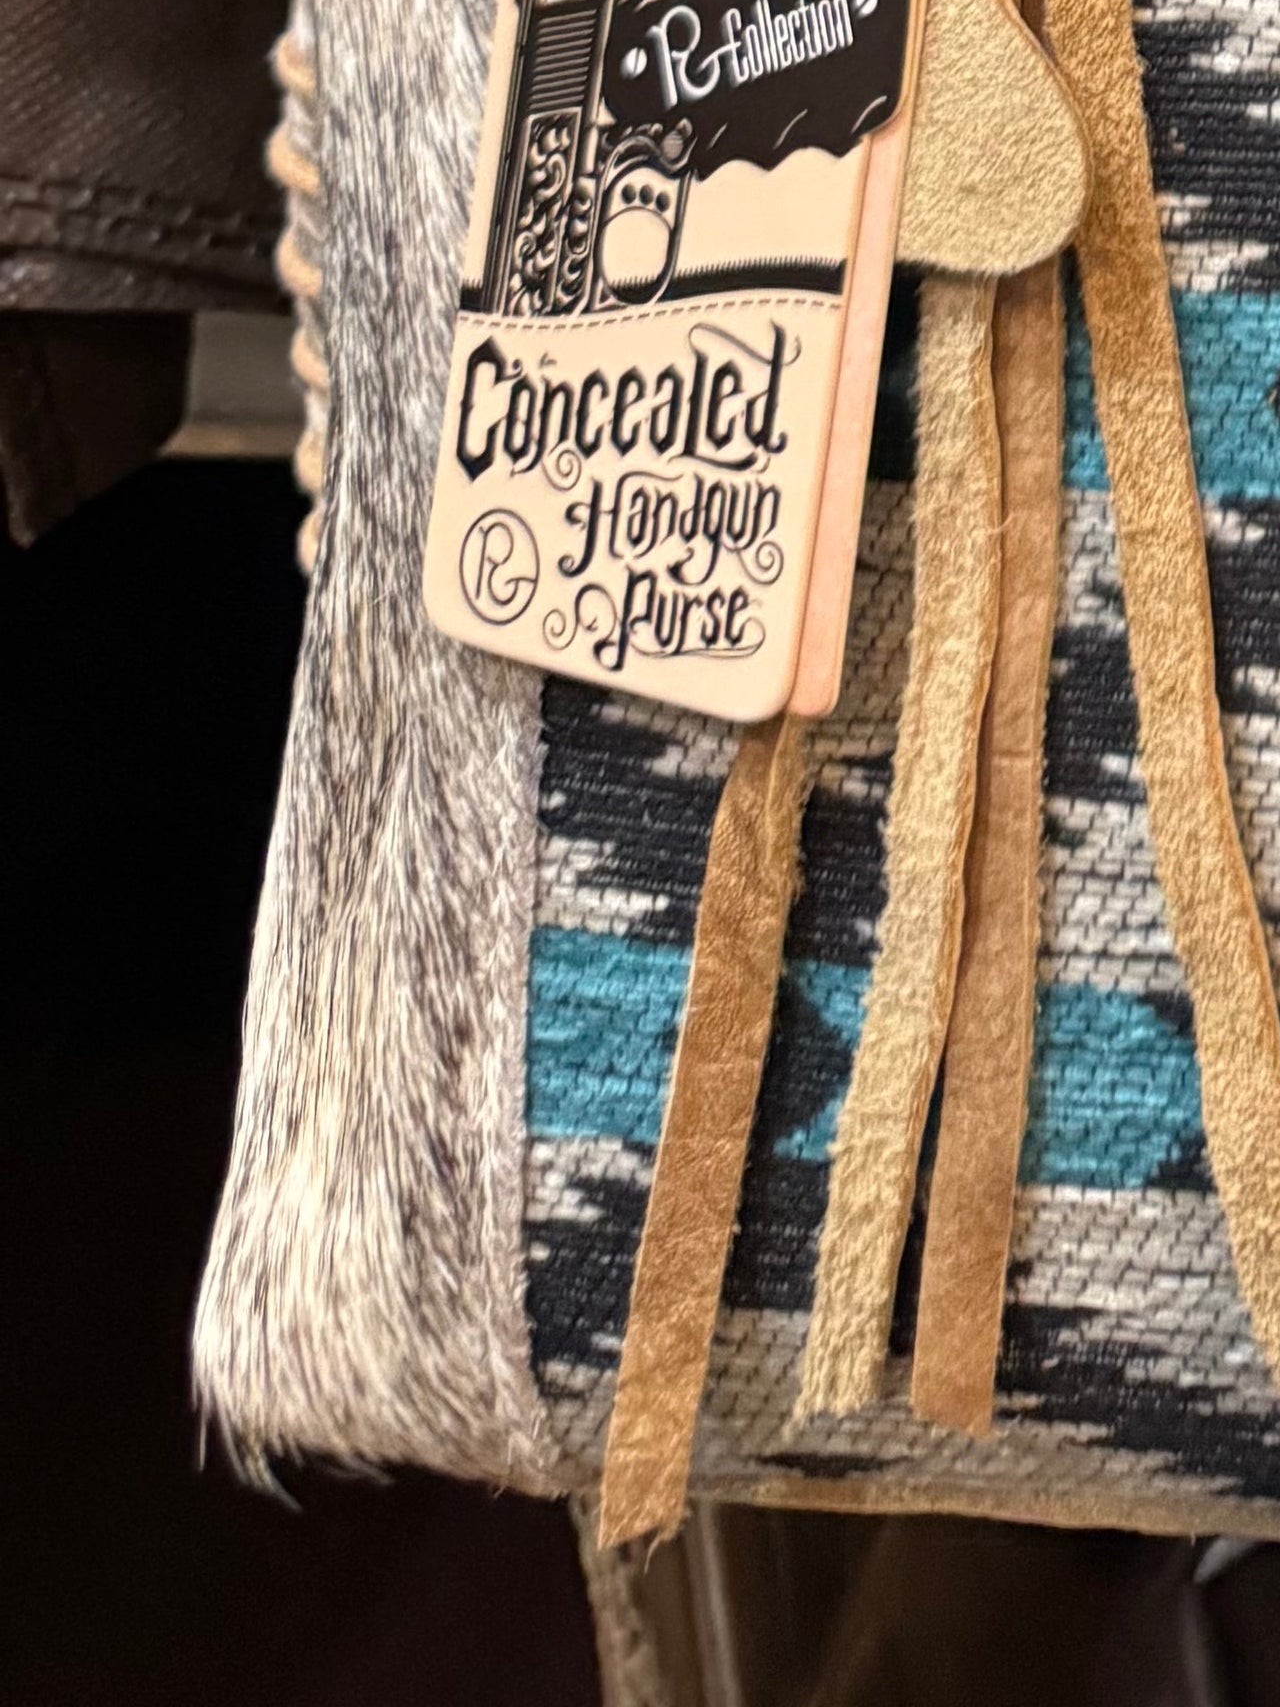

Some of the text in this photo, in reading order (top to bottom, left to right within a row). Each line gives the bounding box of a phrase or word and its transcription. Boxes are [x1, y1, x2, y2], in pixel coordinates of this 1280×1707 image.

[456, 319, 801, 484] Concealed
[557, 471, 784, 585] Handgun
[545, 564, 766, 671] Purse
